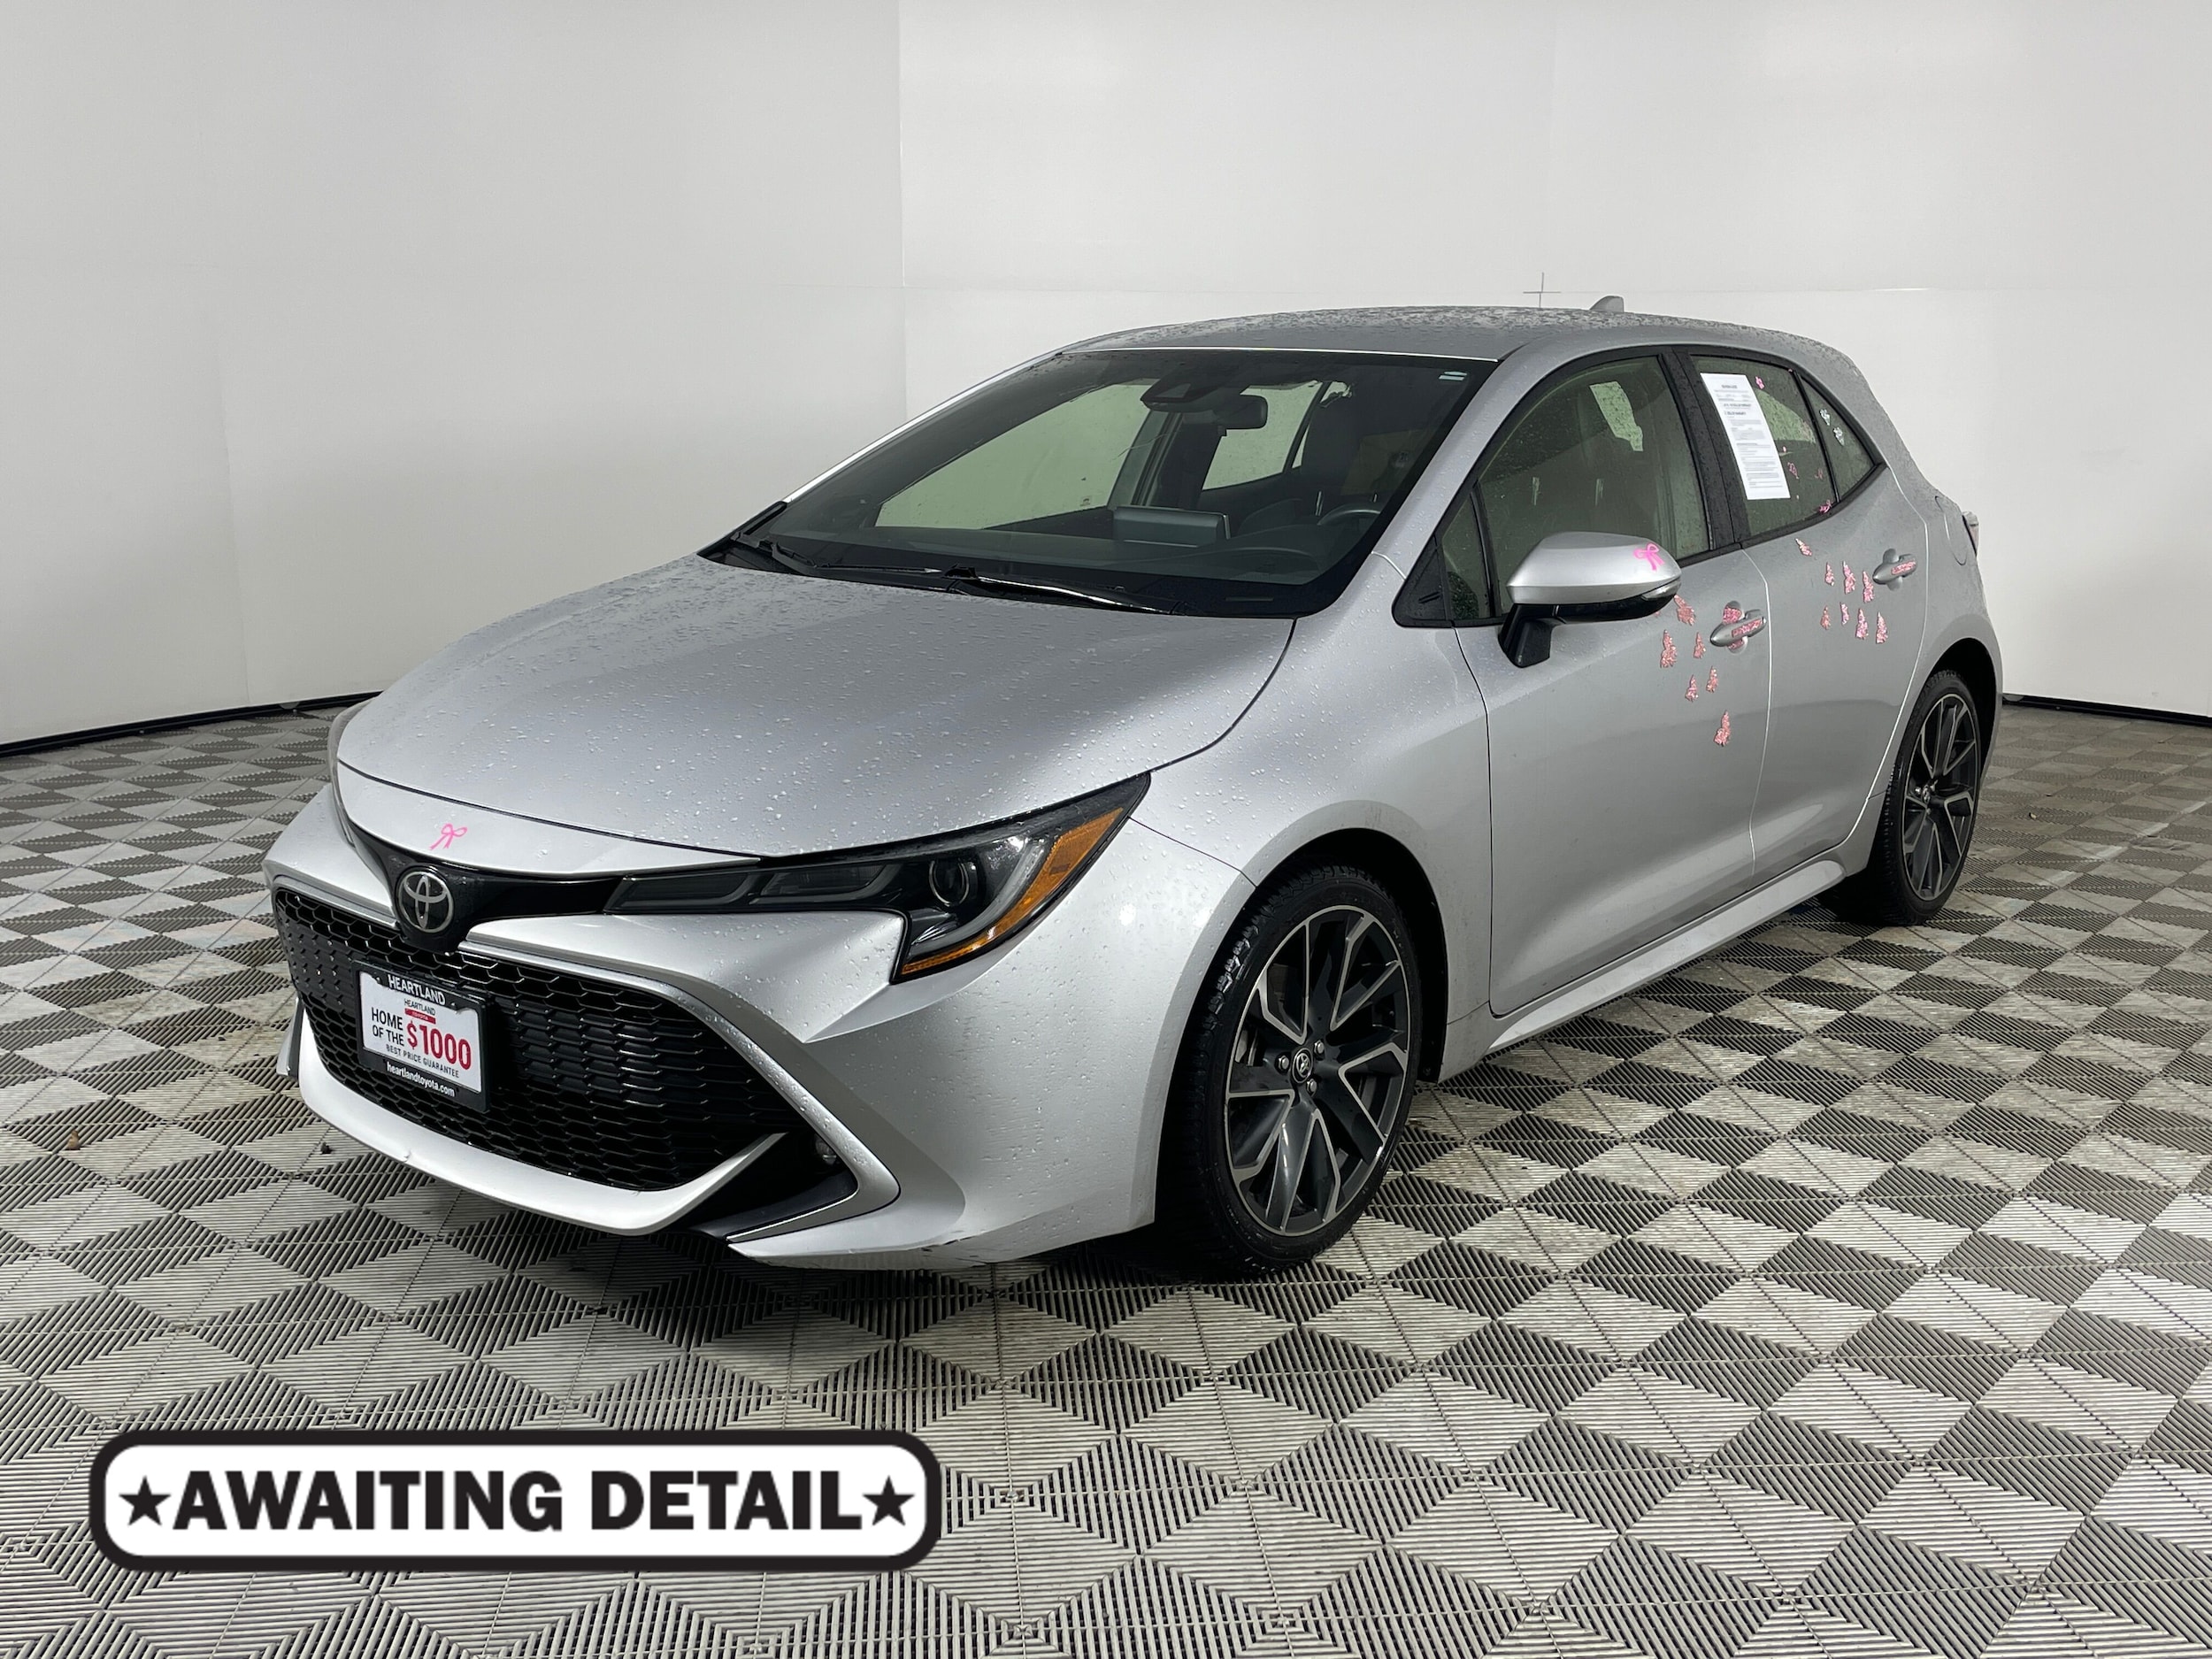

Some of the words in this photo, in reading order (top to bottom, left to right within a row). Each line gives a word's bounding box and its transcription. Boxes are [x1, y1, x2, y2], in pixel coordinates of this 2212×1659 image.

[388, 974, 446, 1006] HEARTLAND
[372, 1007, 403, 1031] HOME
[404, 998, 436, 1016] HEARTLAND
[373, 1025, 384, 1039] OF
[387, 1029, 404, 1047] THE
[406, 1019, 472, 1070] $1000
[386, 1043, 402, 1056] BEST
[403, 1049, 421, 1063] PRICE
[423, 1057, 459, 1079] GUARANTEE
[387, 1062, 455, 1097] heartlandtoyota.com
